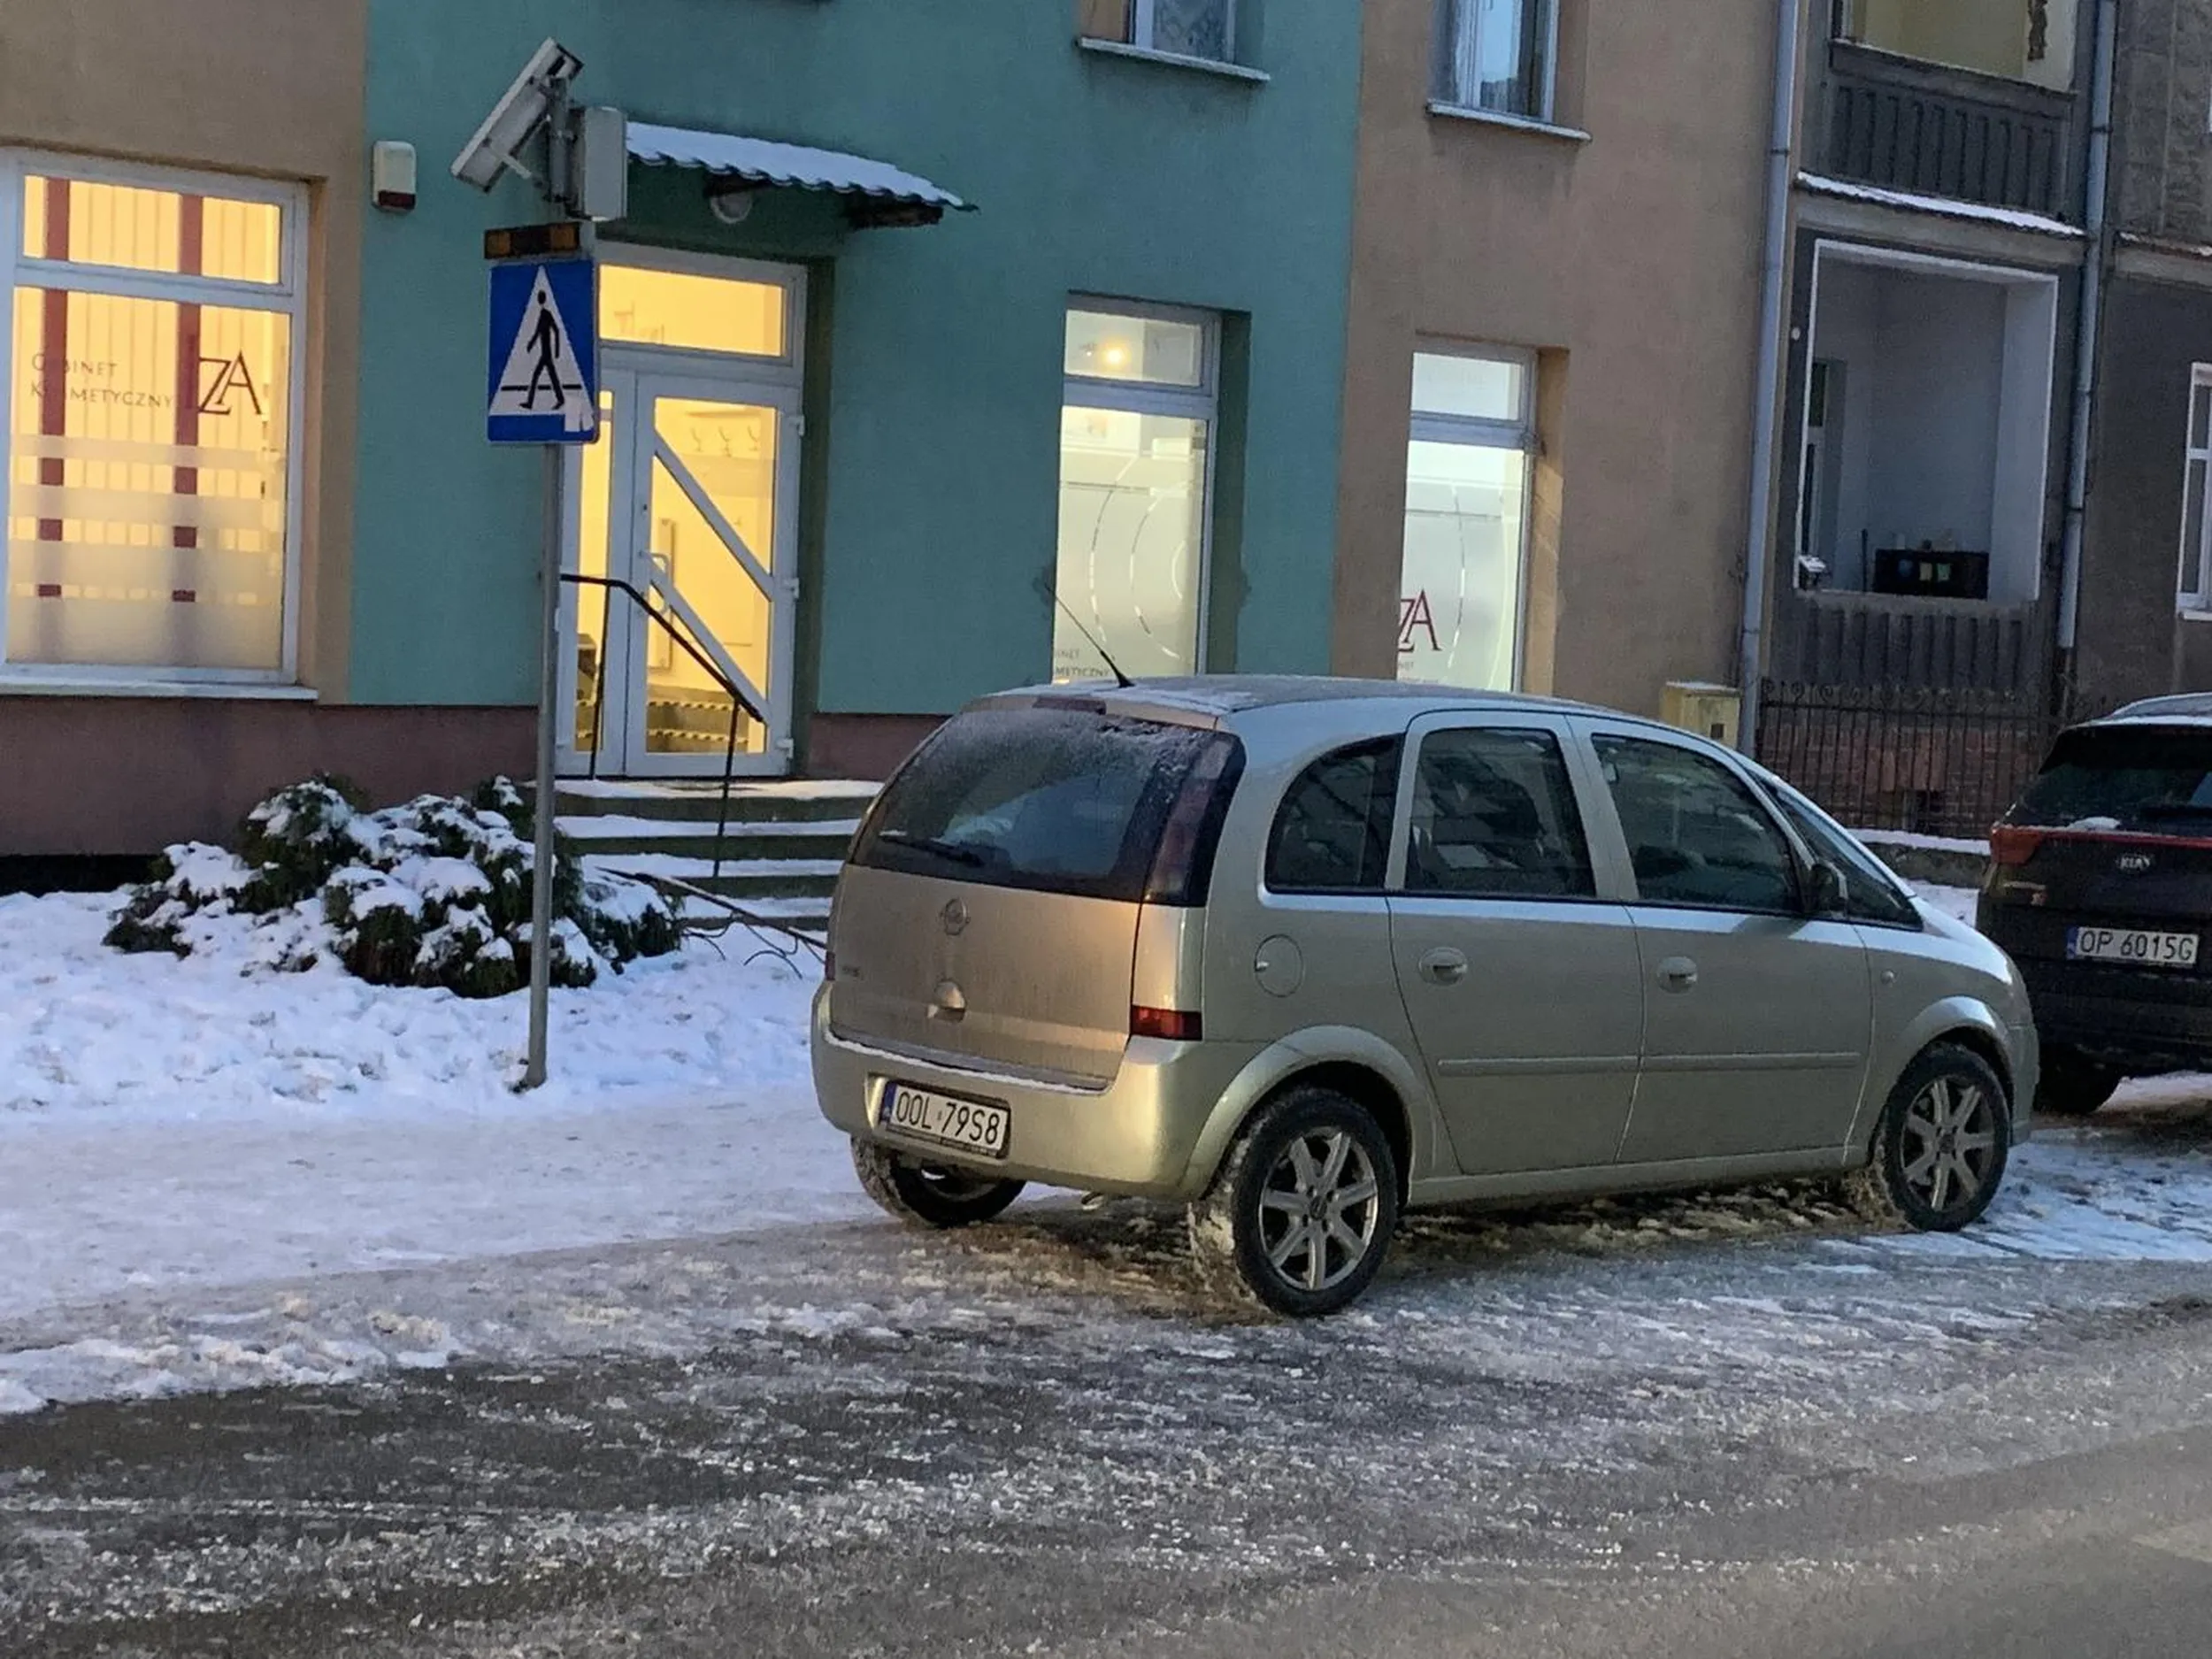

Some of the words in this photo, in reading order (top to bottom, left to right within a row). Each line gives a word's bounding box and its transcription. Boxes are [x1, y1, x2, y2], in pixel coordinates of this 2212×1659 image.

[30, 380, 173, 409] KMETYCZNY
[2080, 931, 2114, 954] OP
[2120, 933, 2194, 961] 6015G
